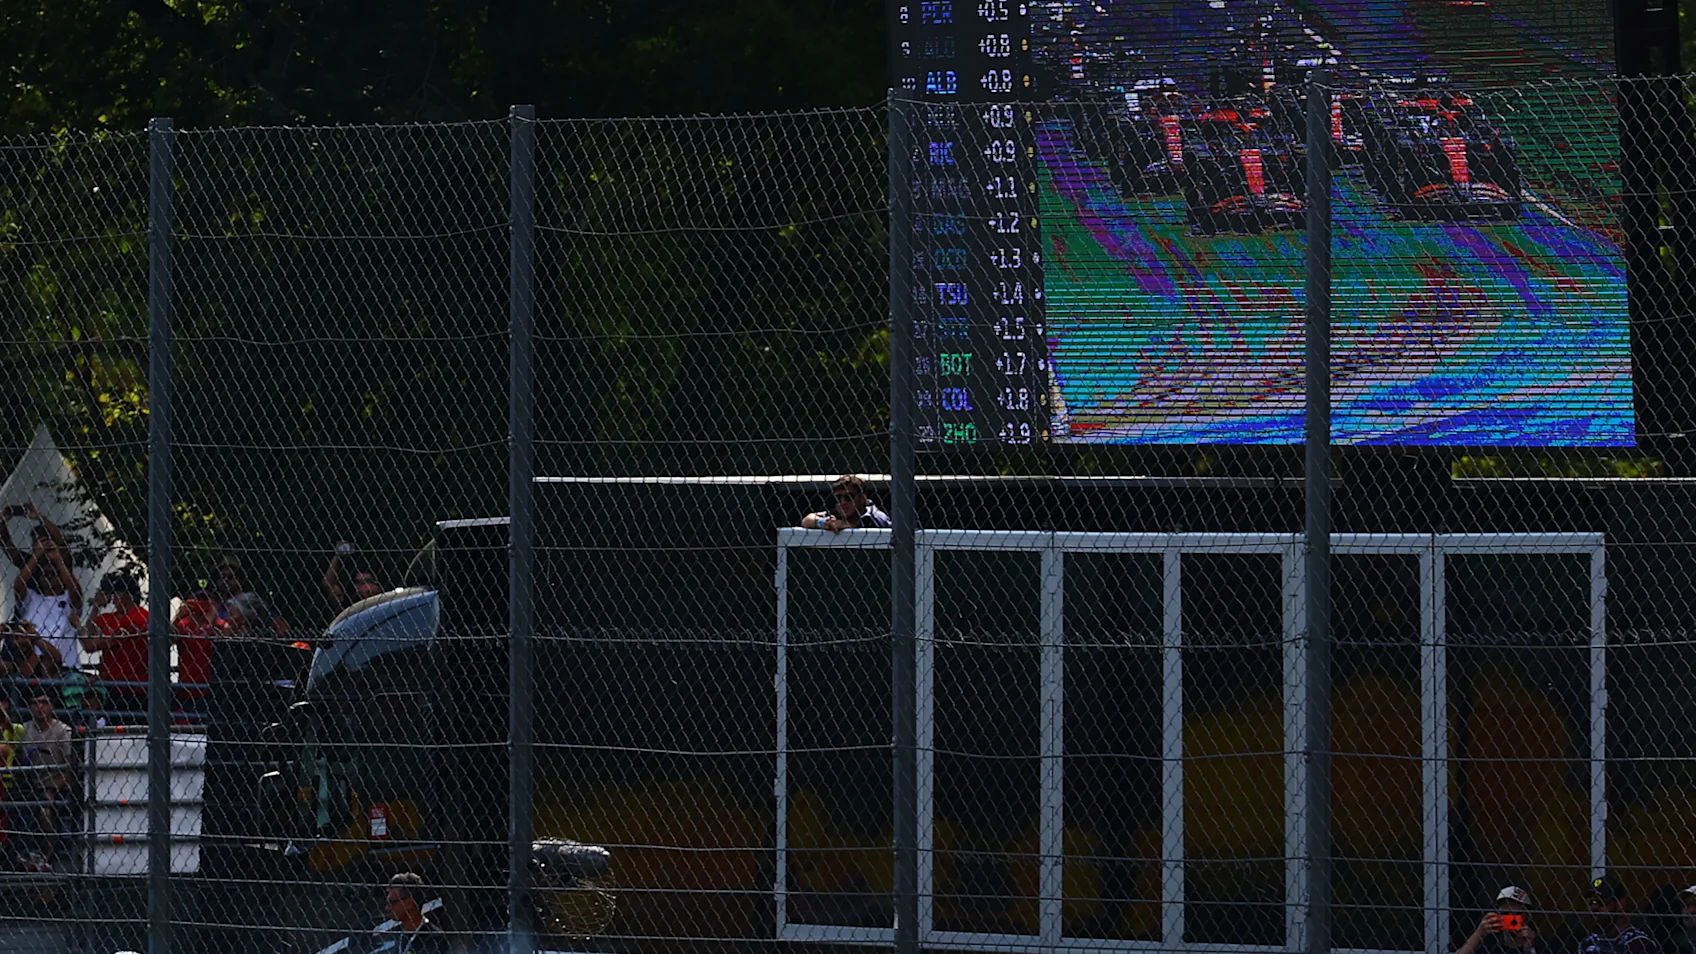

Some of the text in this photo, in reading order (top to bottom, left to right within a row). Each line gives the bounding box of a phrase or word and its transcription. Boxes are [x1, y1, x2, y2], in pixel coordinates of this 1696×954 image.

[977, 0, 1009, 22] +0.5
[978, 34, 1010, 57] +0.8
[925, 71, 957, 94] ALB
[980, 69, 1013, 92] +0.8
[982, 104, 1014, 128] +0.9
[929, 142, 955, 165] RIC
[984, 140, 1016, 163] +0.9
[986, 177, 1018, 198] +1.1
[989, 212, 1020, 233] +1.2
[990, 248, 1022, 269] +1.3
[935, 283, 969, 305] TSU
[993, 282, 1024, 305] +1.4
[994, 317, 1025, 340] +1.5
[940, 352, 972, 376] BOT
[995, 352, 1026, 375] +1.7
[942, 388, 973, 411] COL
[997, 387, 1029, 410] +1.8
[943, 423, 977, 444] ZHO
[999, 423, 1030, 444] +1.9
